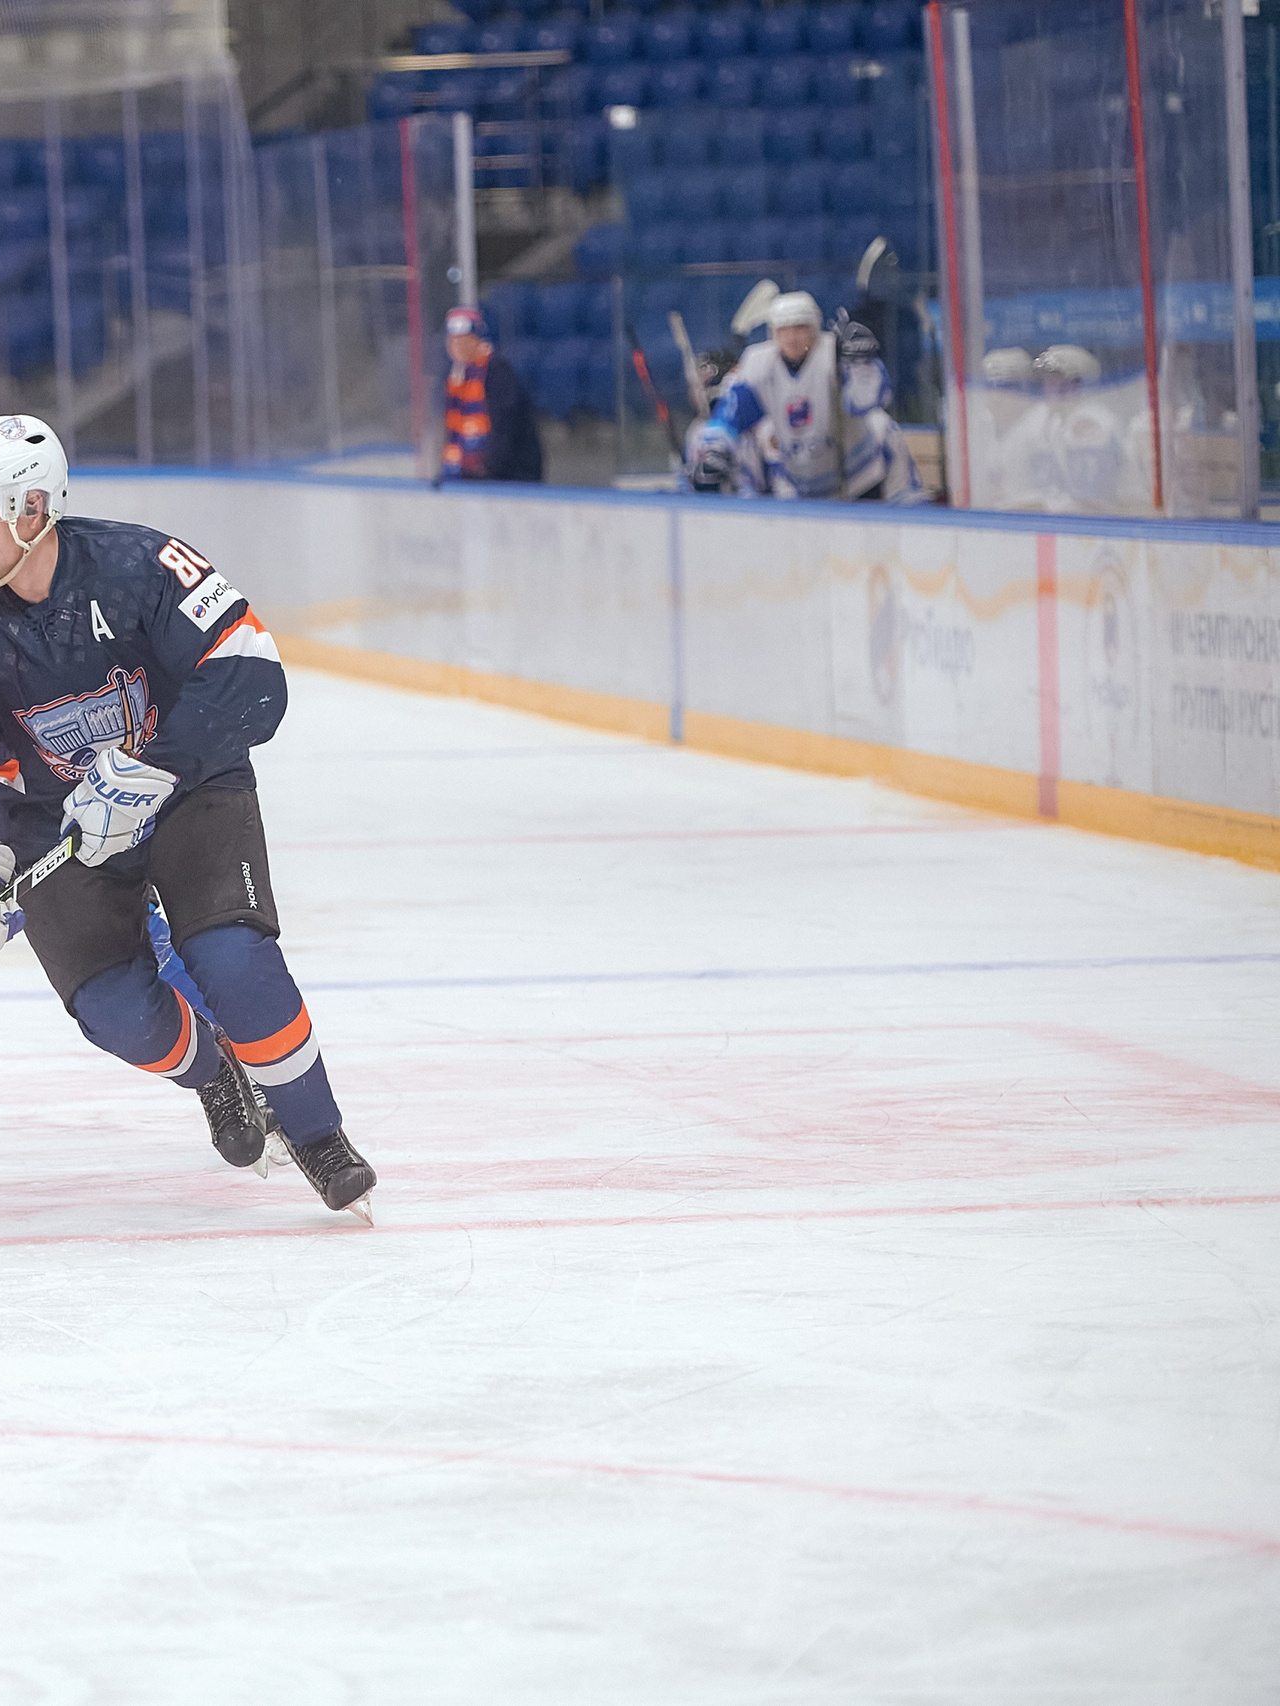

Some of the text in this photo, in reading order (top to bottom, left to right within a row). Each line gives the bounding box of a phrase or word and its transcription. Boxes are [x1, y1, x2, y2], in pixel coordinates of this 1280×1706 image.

[89, 599, 116, 643] A
[87, 764, 159, 808] AUER
[35, 851, 66, 879] CCM
[241, 861, 259, 910] Reebok
